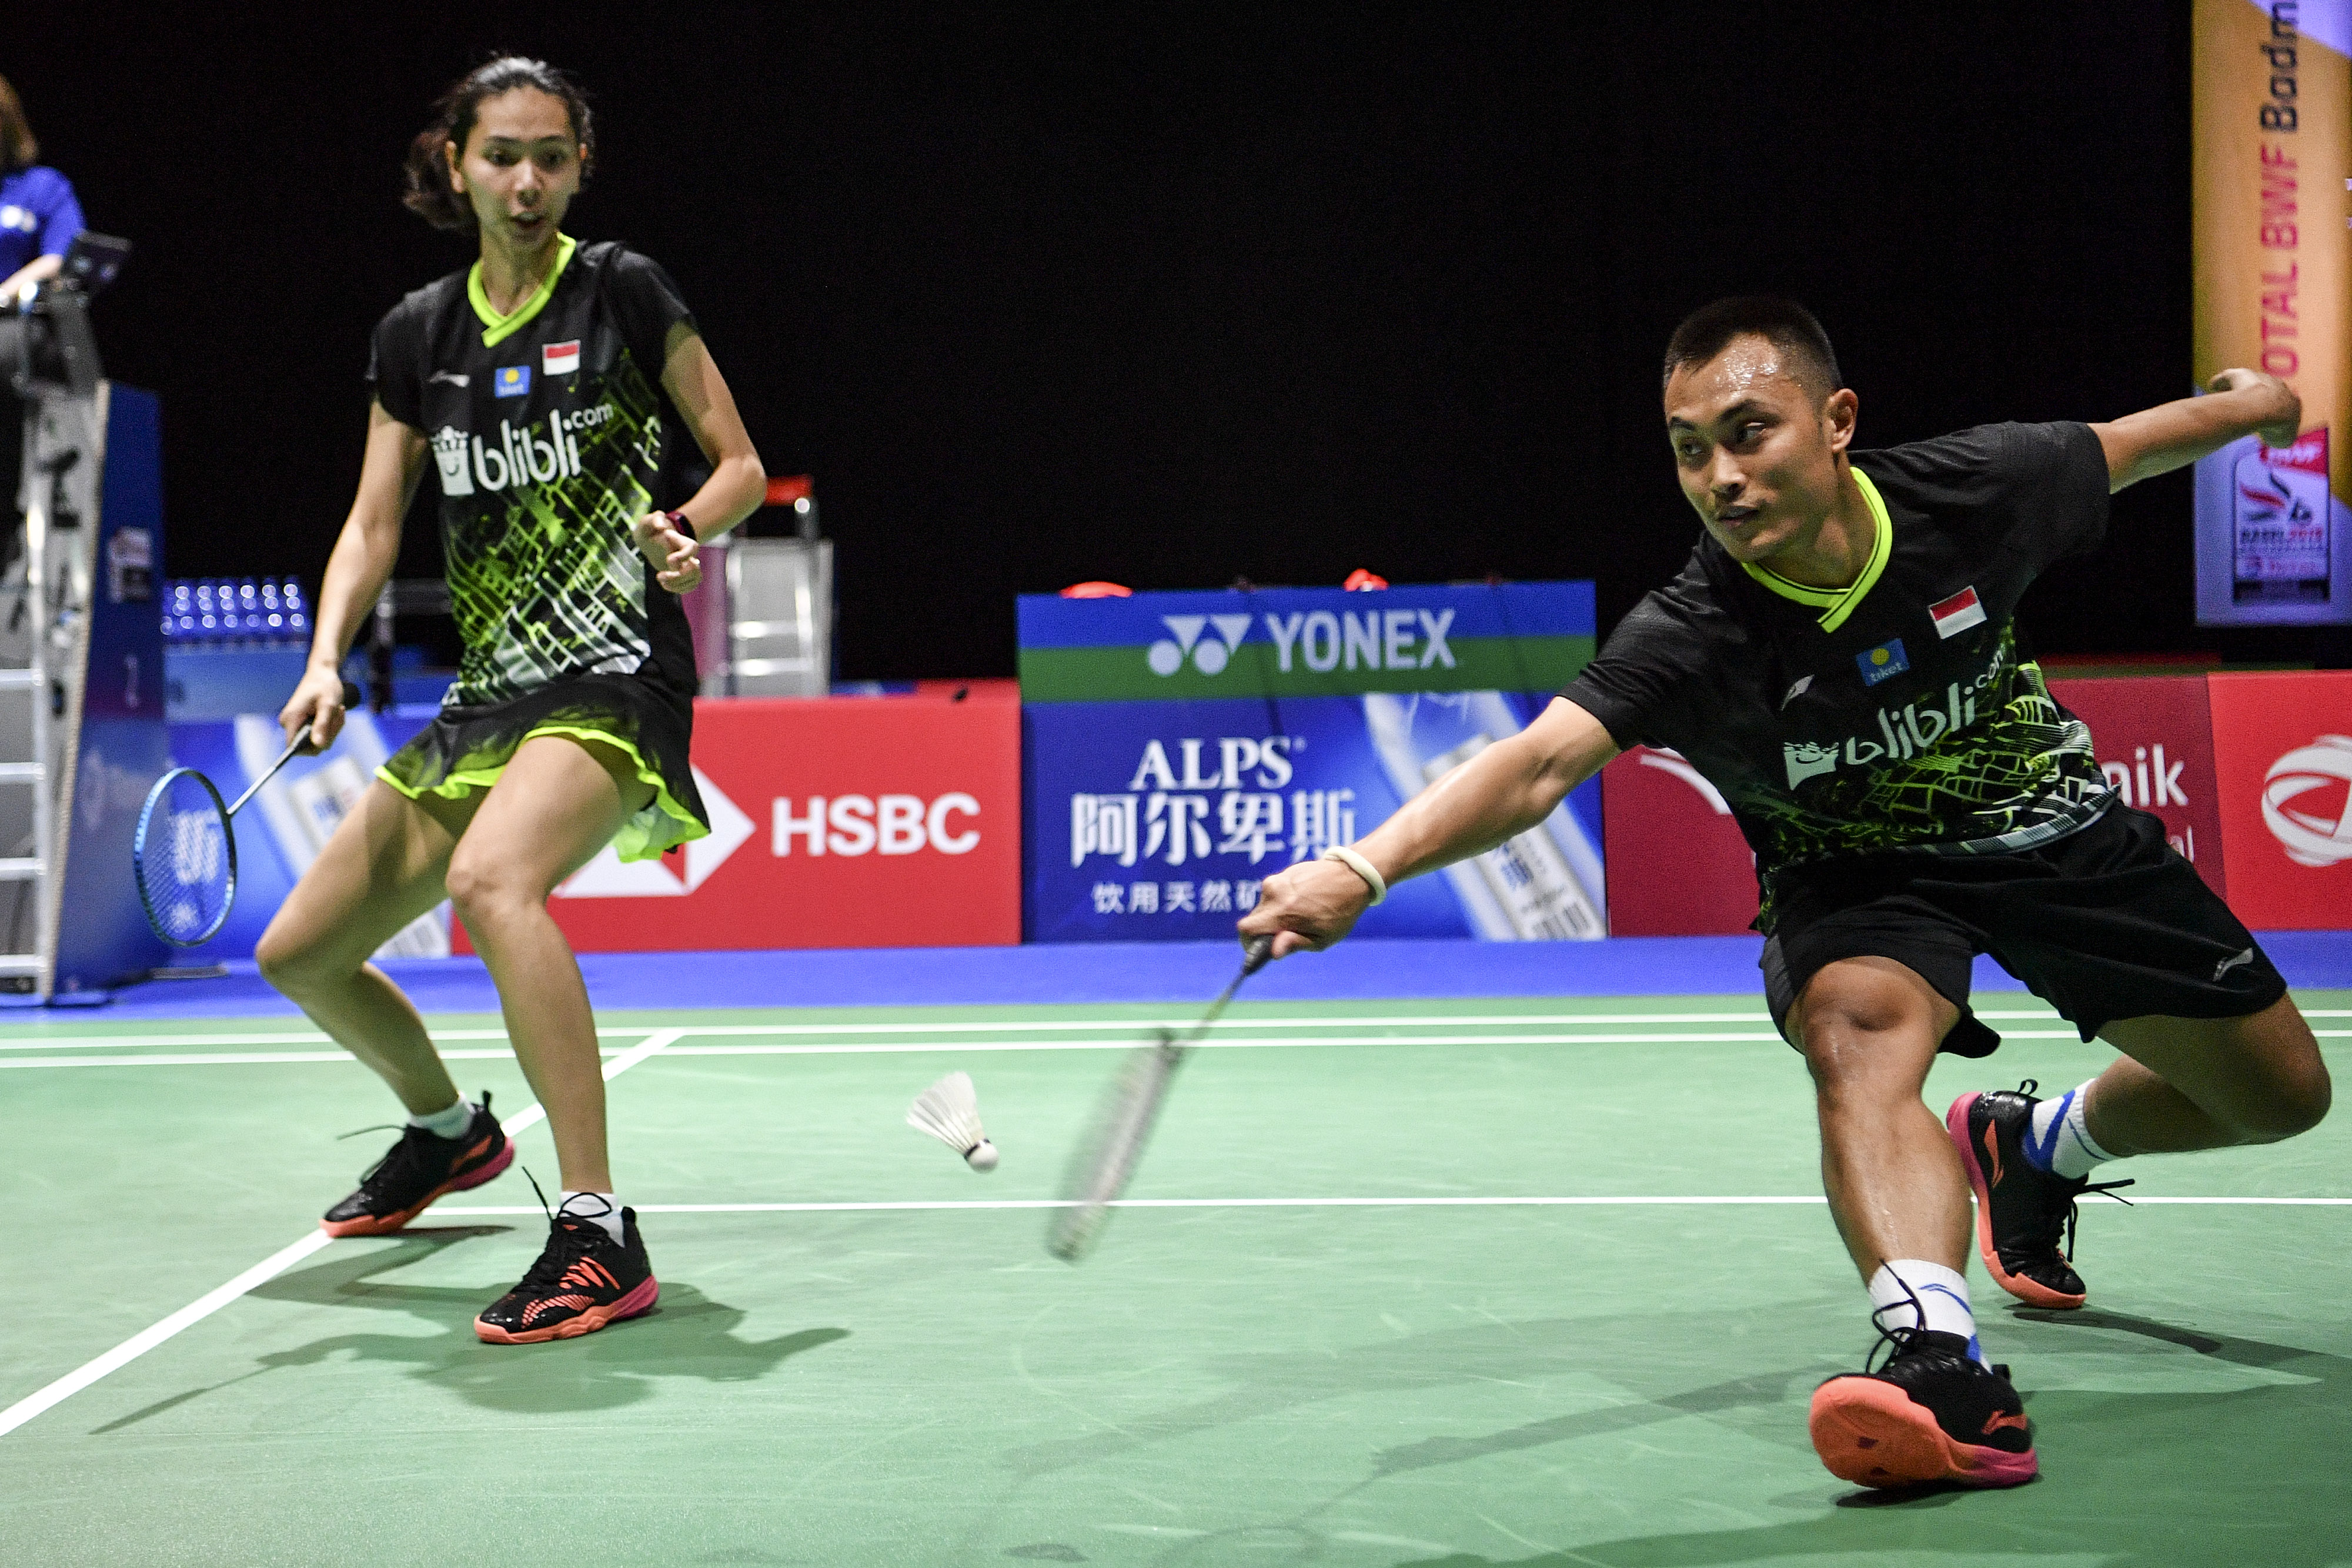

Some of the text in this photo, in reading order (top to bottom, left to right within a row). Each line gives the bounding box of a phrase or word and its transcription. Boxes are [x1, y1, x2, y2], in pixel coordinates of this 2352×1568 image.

[2259, 2, 2300, 394] OTAL BWF Badm
[1264, 608, 1456, 673] YONEX
[1131, 736, 1294, 790] ALPS
[771, 791, 981, 857] HSBC
[1070, 788, 1356, 868] 阿尔卑斯
